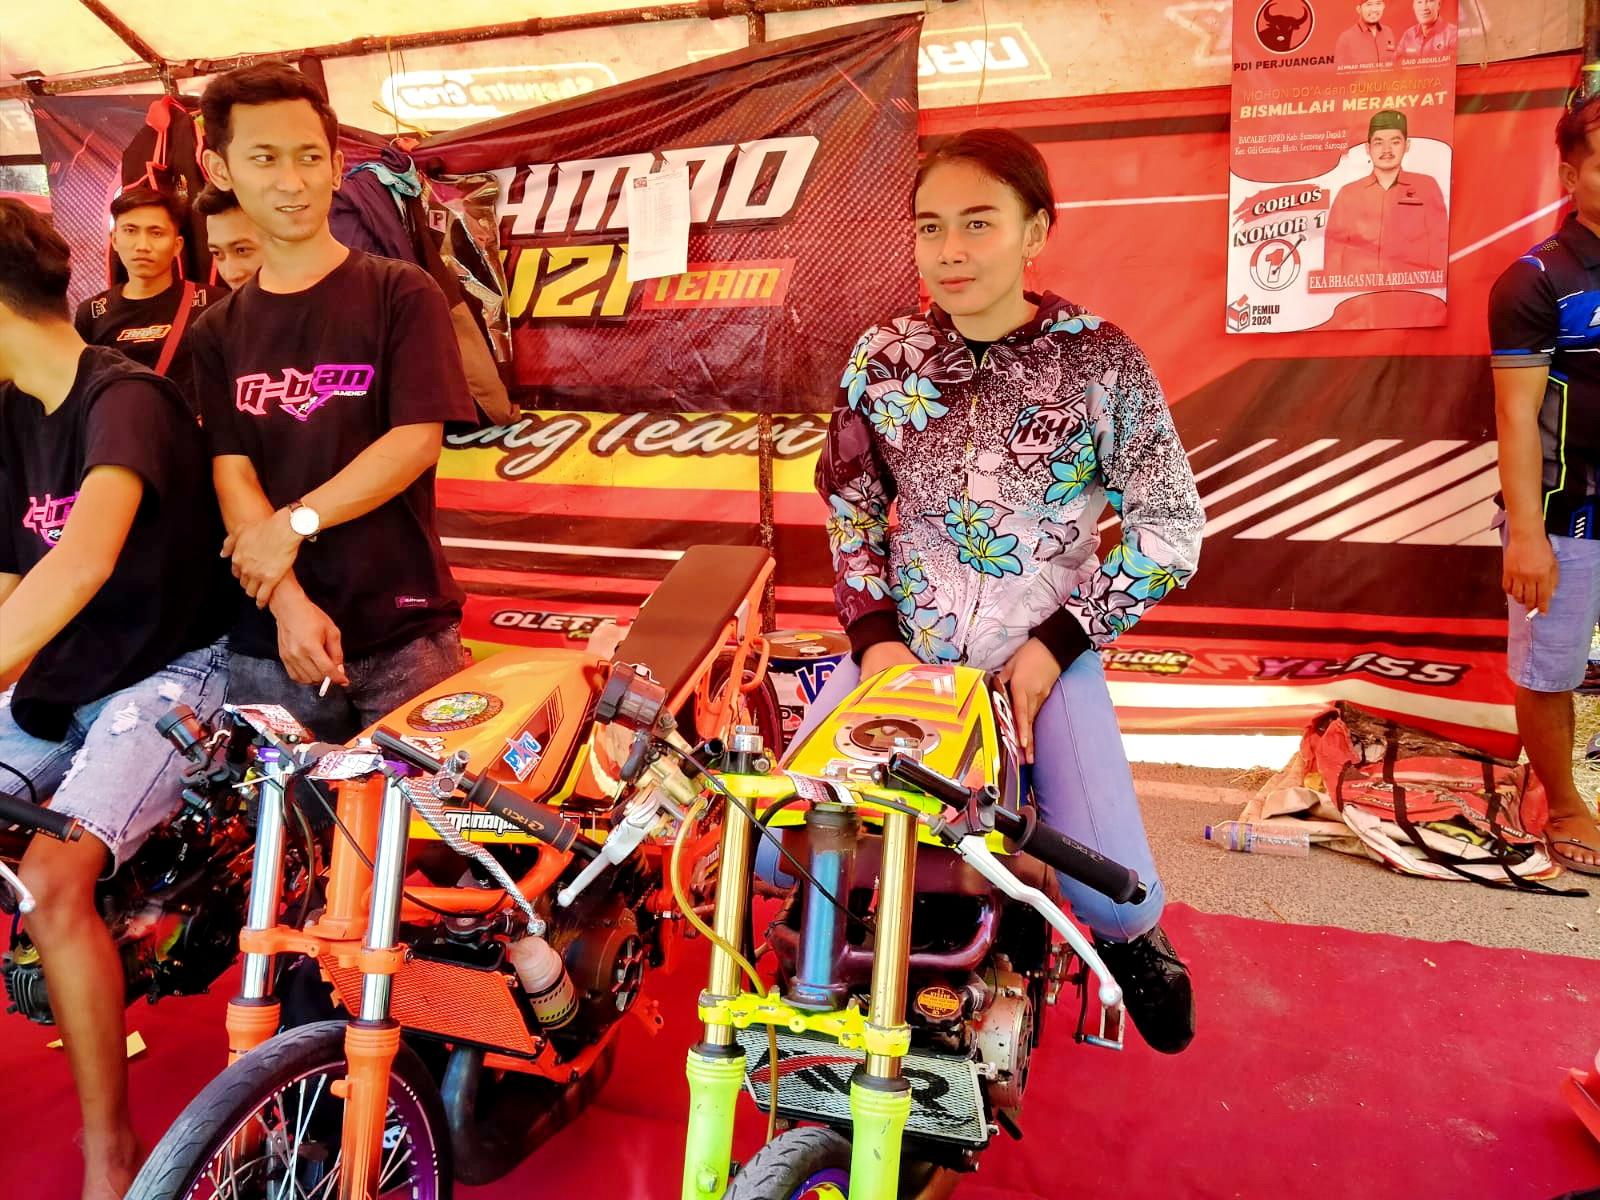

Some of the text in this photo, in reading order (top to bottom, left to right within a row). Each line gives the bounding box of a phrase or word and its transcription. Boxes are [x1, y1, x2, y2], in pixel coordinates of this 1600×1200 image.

[1234, 56, 1335, 71] PDI PERJUANGAN
[1243, 78, 1442, 102] MOHON DO'A dan DUKUNGANNYA
[1240, 91, 1448, 119] BISMILLAH MERAKYAT
[1268, 133, 1285, 143] DPRD
[1252, 188, 1322, 216] COBLOS
[1234, 211, 1326, 247] NOMOR 1
[655, 267, 783, 303] TEAM
[1309, 270, 1443, 289] EKA BHAGAS NUR ARDIANSYAH
[1252, 304, 1280, 315] PEMILU
[1251, 315, 1272, 326] 2024
